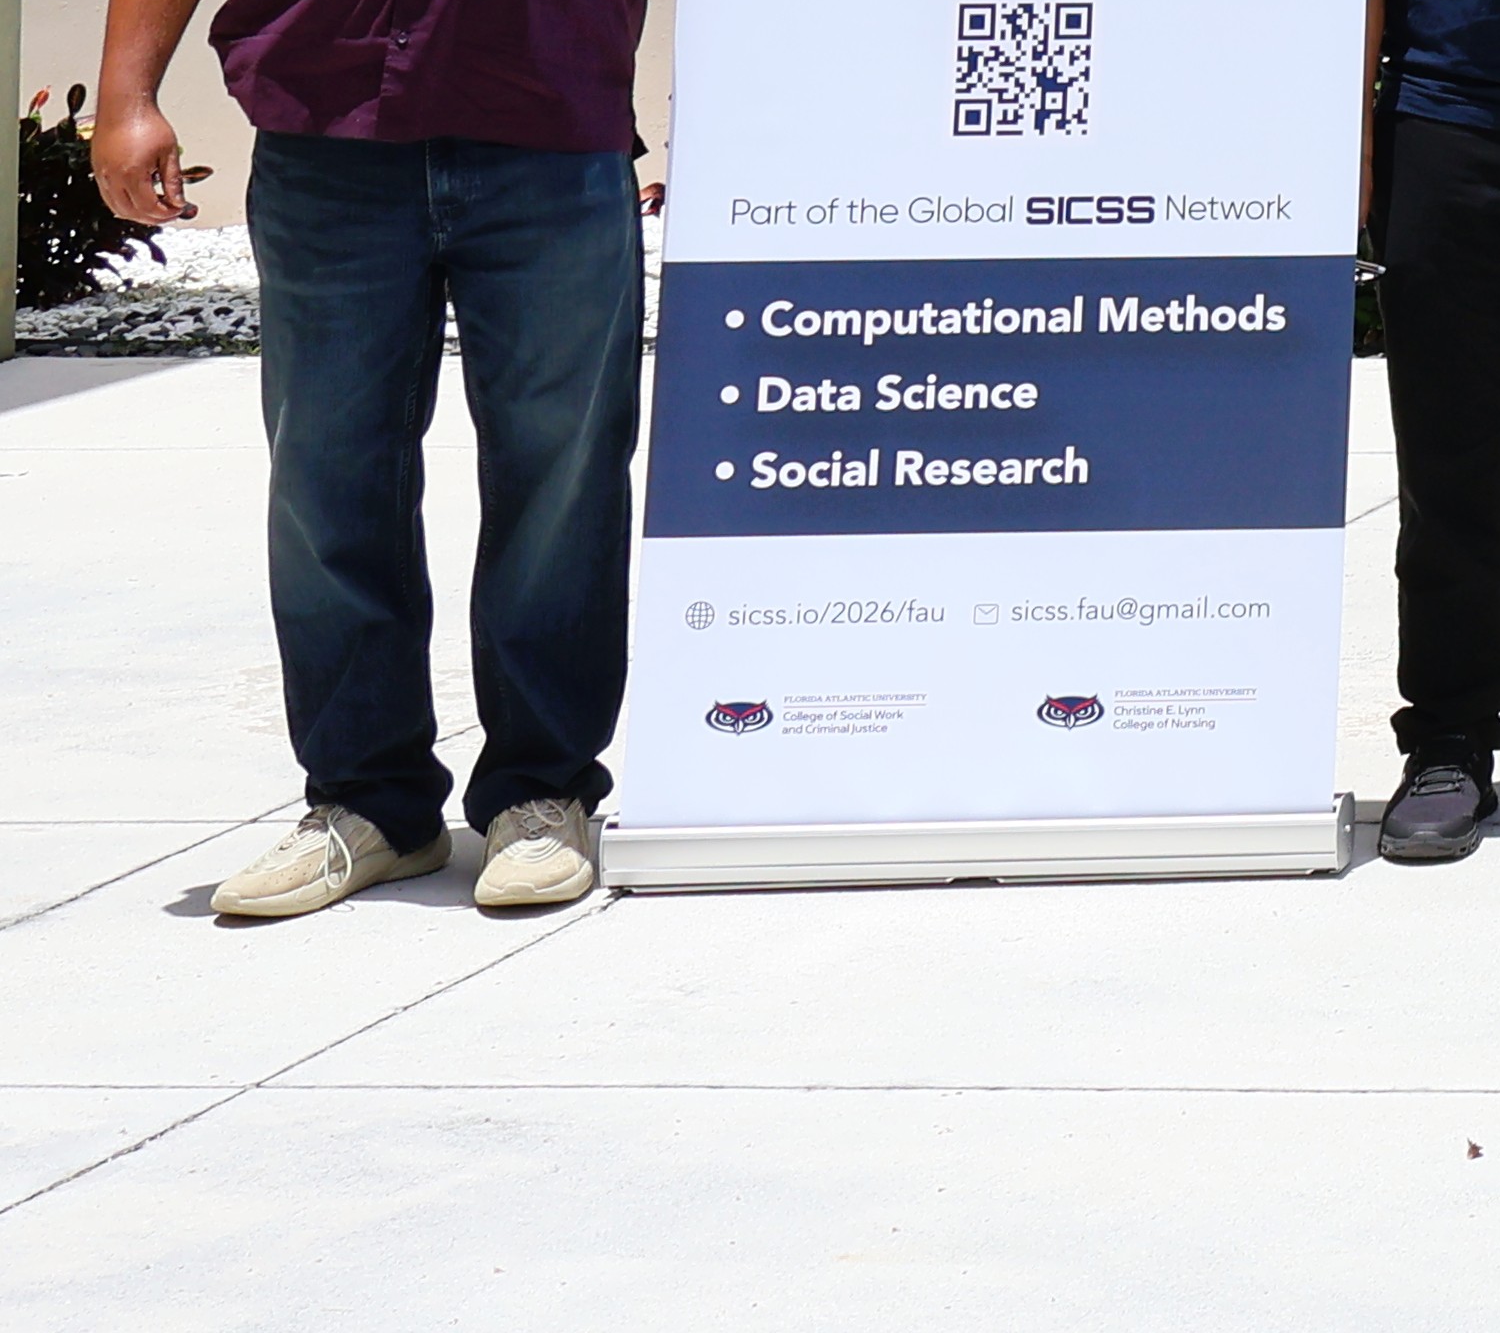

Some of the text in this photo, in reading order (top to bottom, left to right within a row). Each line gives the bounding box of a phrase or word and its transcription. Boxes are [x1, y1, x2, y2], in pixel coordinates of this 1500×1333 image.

[731, 193, 1292, 226] Part of the Global SICSS Network
[761, 294, 1286, 345] Computational Methods
[756, 375, 1038, 413] Data Science
[751, 447, 1089, 490] Social Research
[727, 600, 946, 628] sicss.io/2026/fau
[1010, 595, 1271, 626] sicss.fau@gmail.com
[784, 695, 823, 703] FLORIDA
[872, 693, 926, 702] UNIVERSITY
[1155, 689, 1201, 697] ATLANTIC
[1202, 688, 1256, 696] UNIVERSITY
[783, 709, 904, 723] College of Social Work
[1114, 705, 1206, 717] Christine E. Lynn
[782, 723, 888, 735] and Criminal Justice
[1113, 718, 1215, 731] College of Nursing
